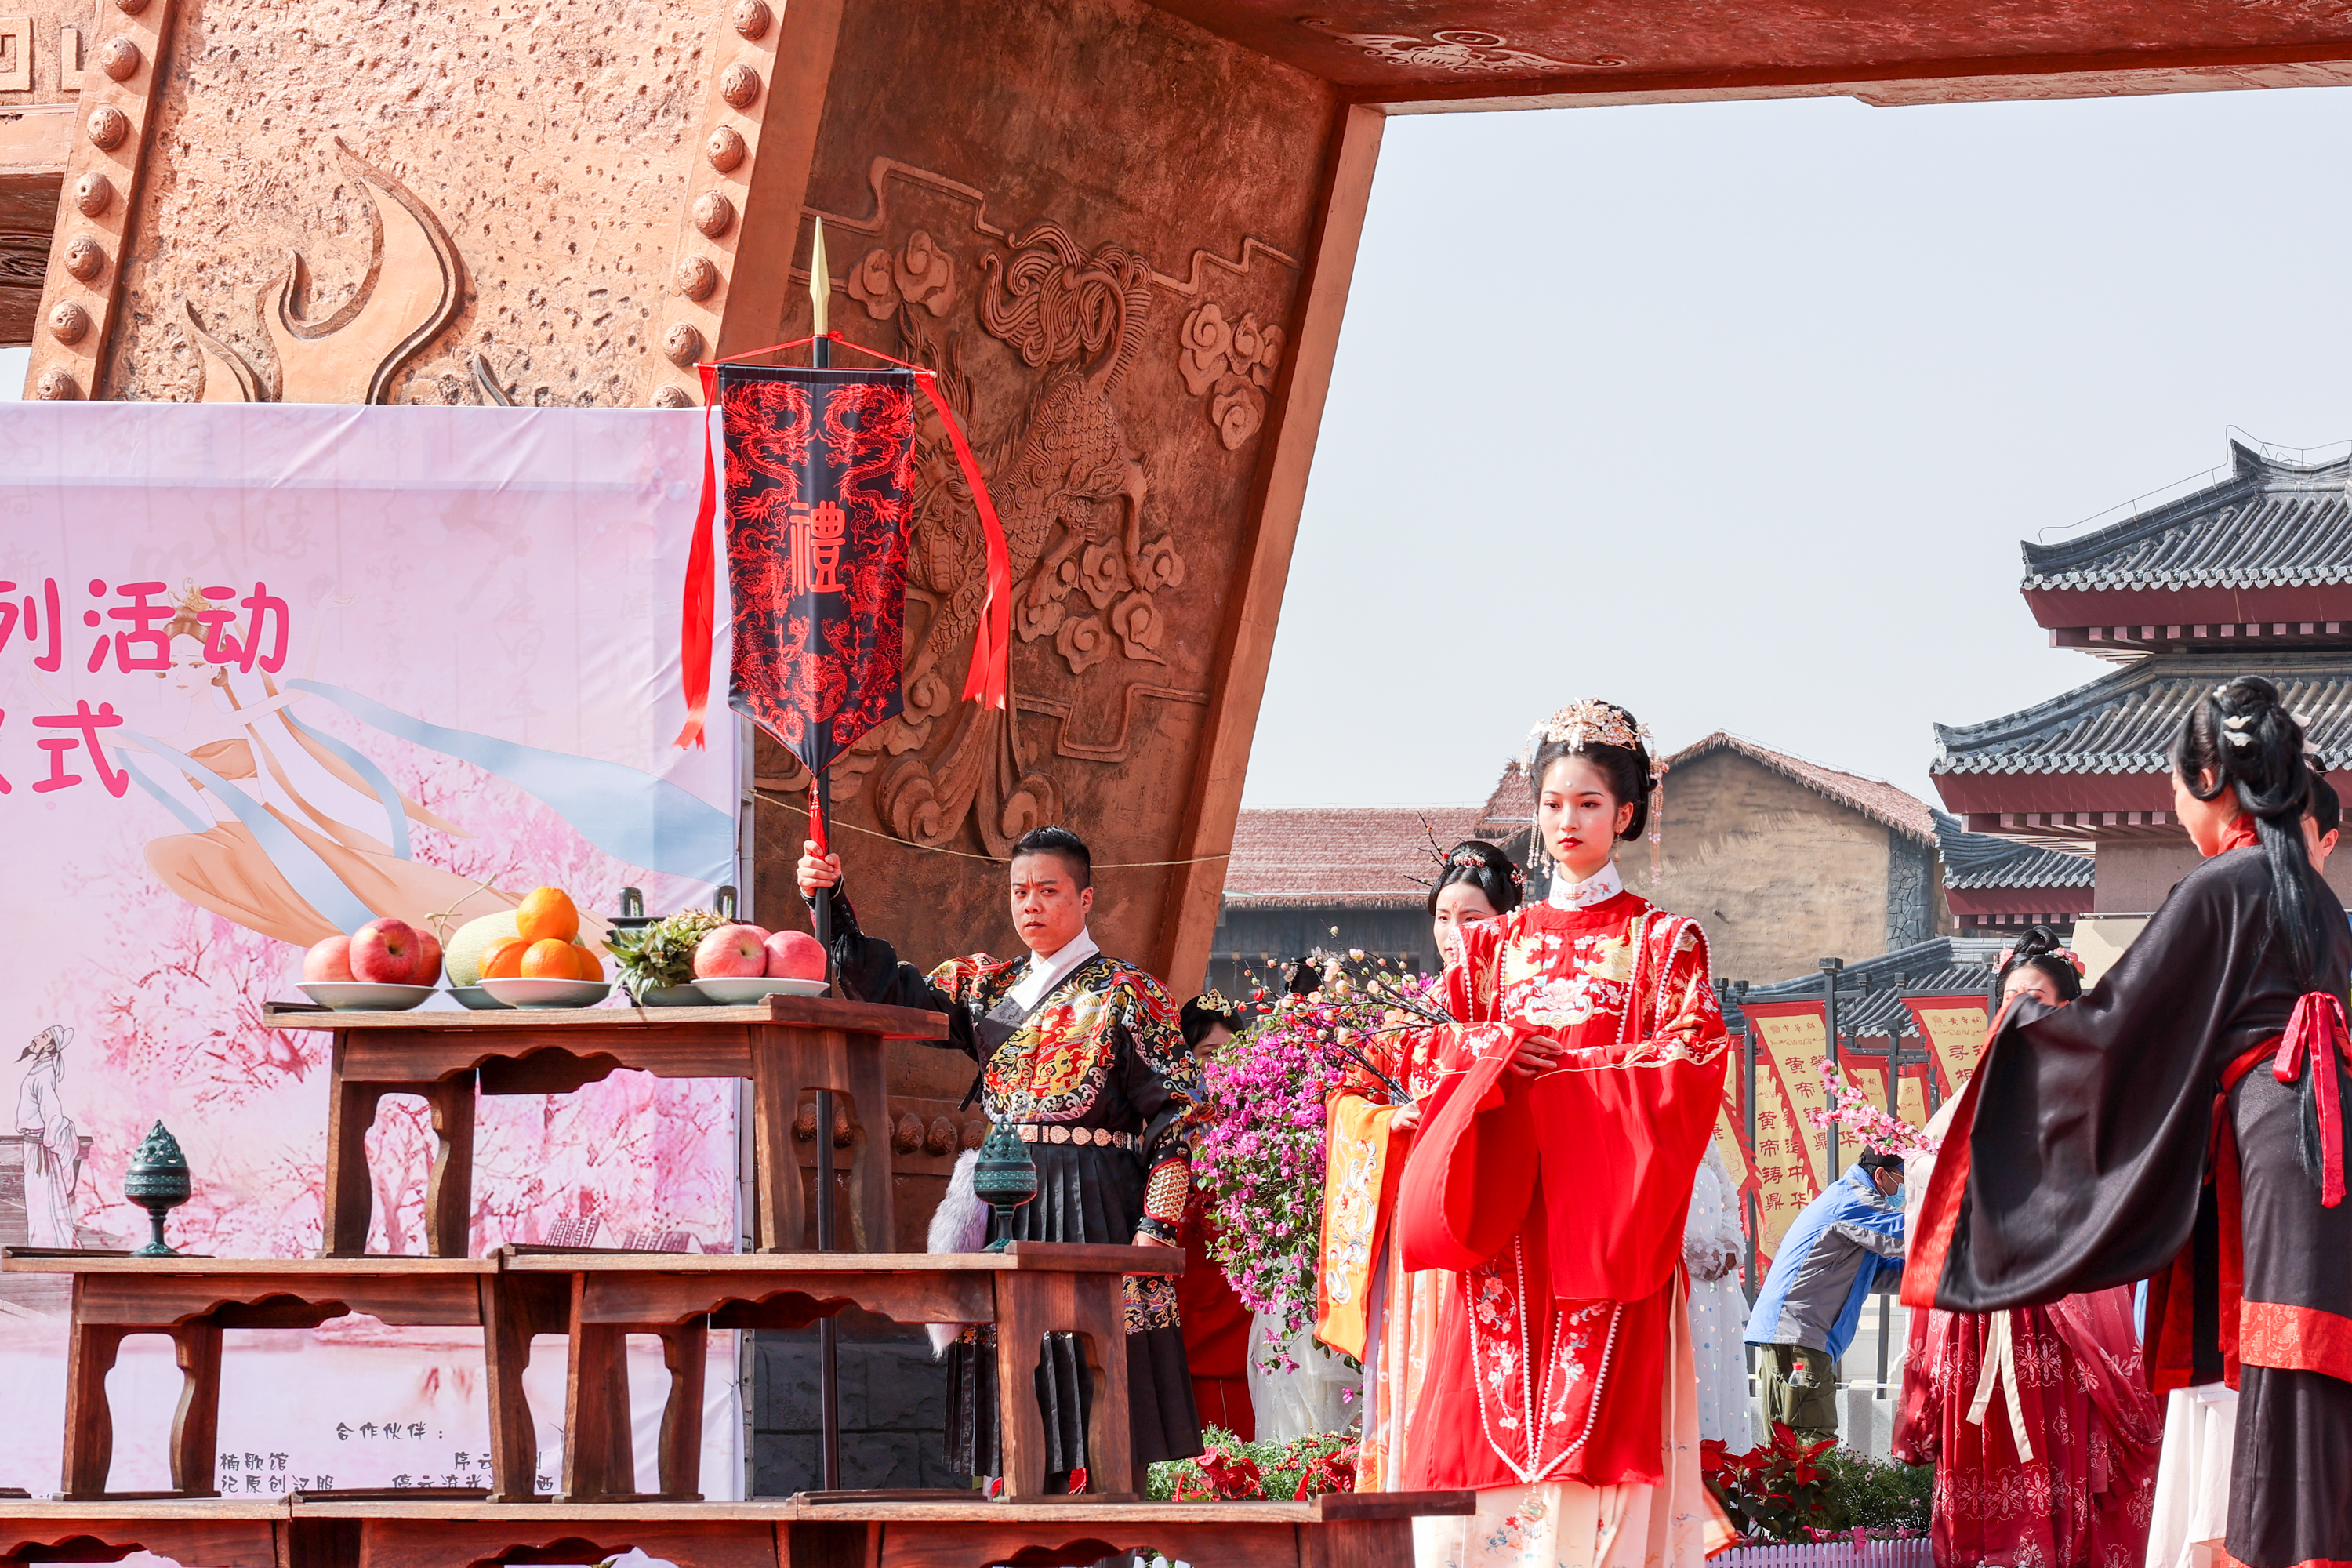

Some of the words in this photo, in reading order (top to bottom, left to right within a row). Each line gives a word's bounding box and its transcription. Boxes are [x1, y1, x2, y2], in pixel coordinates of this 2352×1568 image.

[789, 499, 846, 597] 禮
[0, 577, 289, 674] 列活动
[0, 699, 129, 799] 式
[1757, 1110, 1784, 1211] 黄帝铸鼎
[220, 1452, 289, 1472] 楠歌馆
[221, 1474, 334, 1494] 记原创汉服
